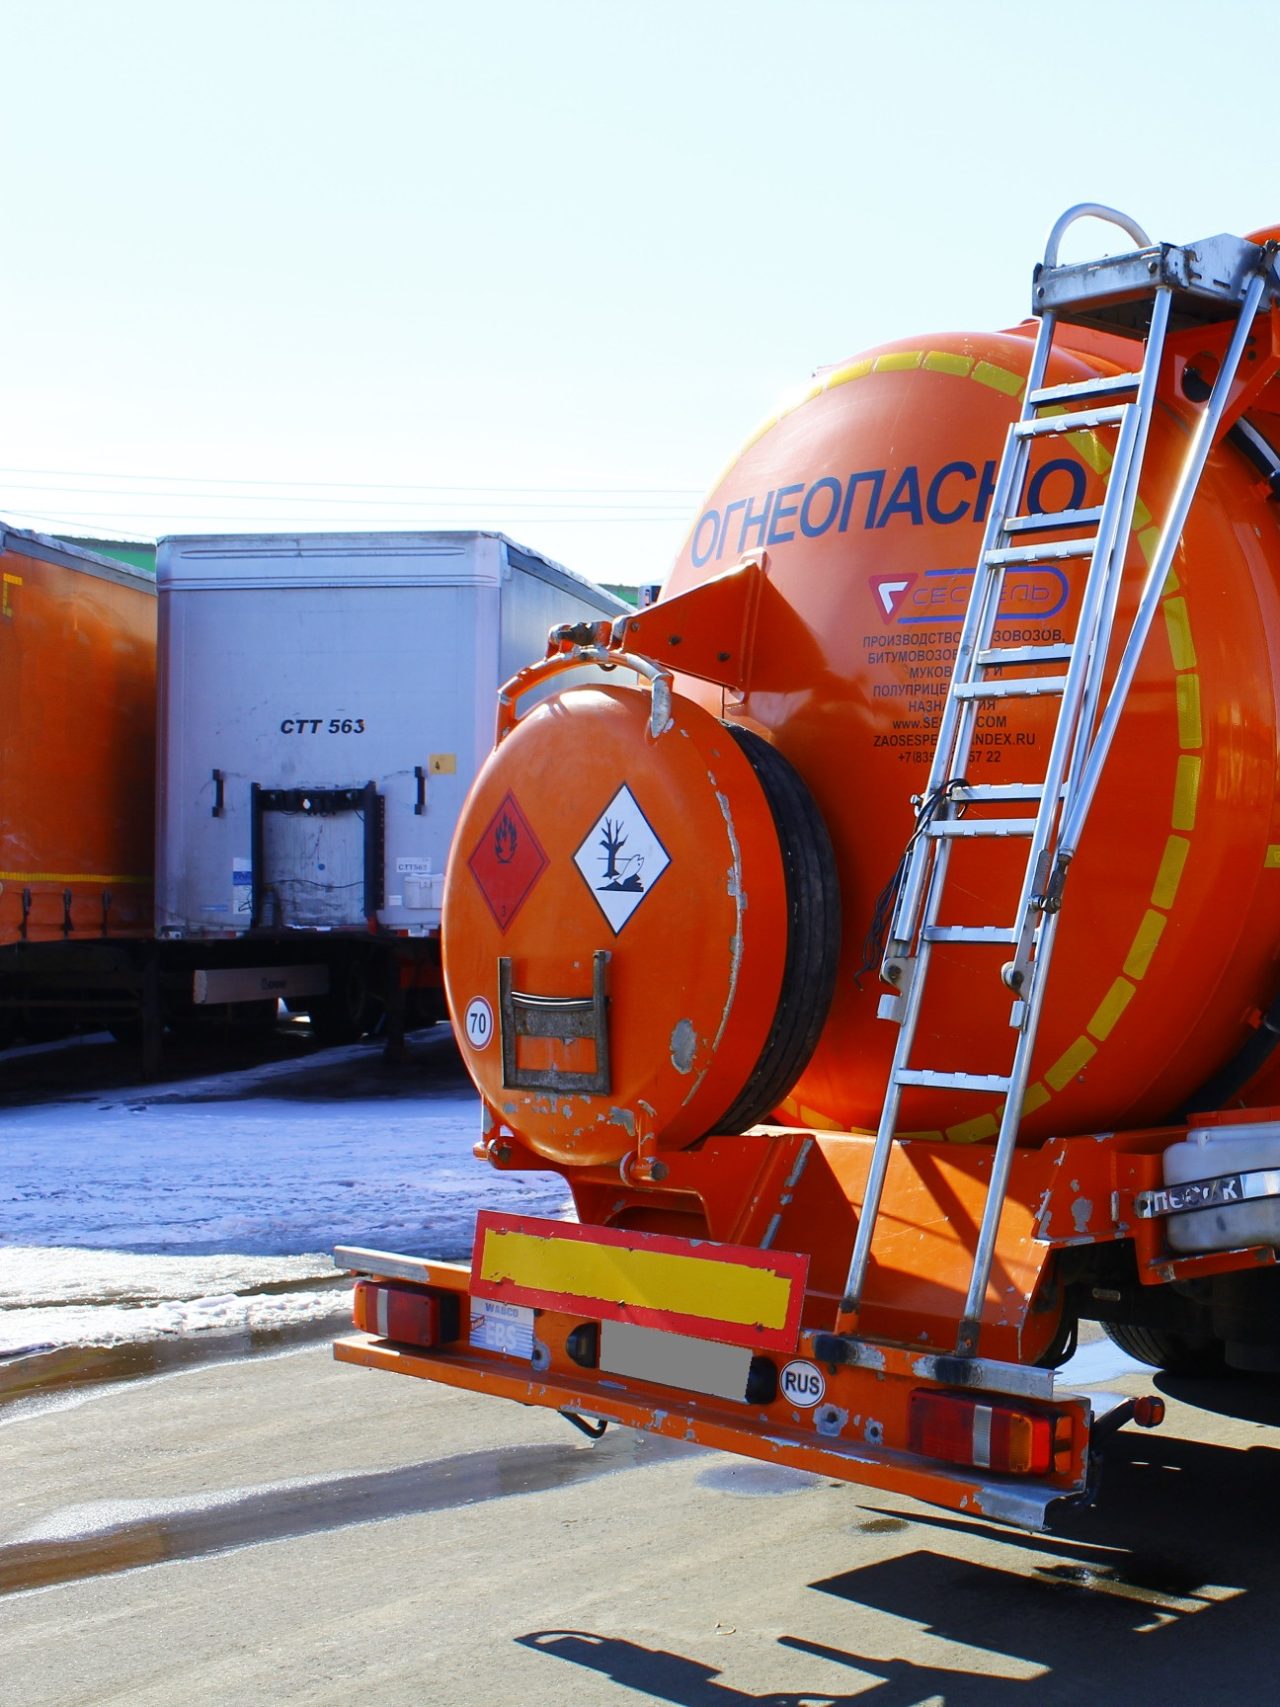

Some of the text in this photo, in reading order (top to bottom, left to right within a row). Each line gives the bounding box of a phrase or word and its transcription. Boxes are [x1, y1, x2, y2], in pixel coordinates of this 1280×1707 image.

[863, 631, 962, 648] ПРОИЗВОДСТВО
[328, 718, 365, 735] 563
[470, 1012, 487, 1034] 70
[485, 1303, 519, 1318] WABCO
[485, 1321, 517, 1350] EBS
[785, 1371, 820, 1396] RUS
